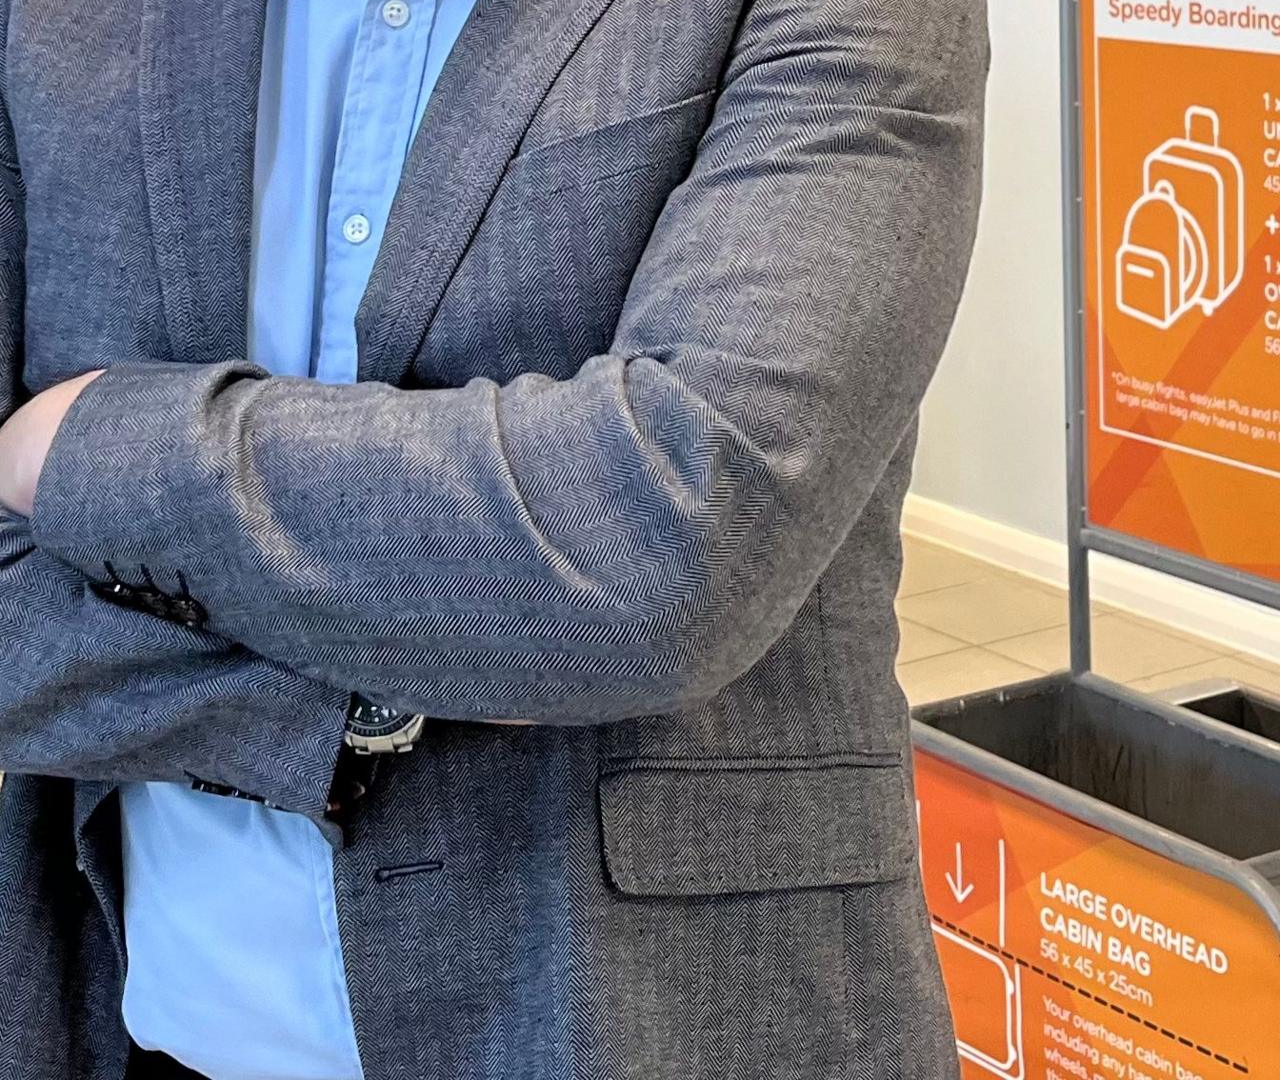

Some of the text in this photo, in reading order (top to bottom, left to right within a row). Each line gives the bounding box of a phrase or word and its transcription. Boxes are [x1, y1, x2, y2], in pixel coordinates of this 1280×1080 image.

[1263, 92, 1271, 111] 1
[1264, 255, 1272, 274] 1
[1115, 389, 1140, 407] large
[1141, 395, 1168, 413] cabin
[1168, 403, 1188, 421] bag
[1189, 410, 1212, 426] may
[1212, 413, 1237, 431] have
[1237, 420, 1250, 435] to
[1250, 426, 1265, 440] go
[1266, 428, 1277, 440] in
[1131, 375, 1154, 395] busy
[1228, 399, 1250, 417] Plus
[1251, 406, 1271, 422] and
[1040, 872, 1228, 974] LARGE OVERHEAD
[1040, 908, 1151, 977] CABIN BAG
[1040, 938, 1153, 1007] 56 x 45 x 25cm
[1042, 994, 1071, 1021] Your
[1073, 1014, 1134, 1054] overhead
[1135, 1046, 1173, 1074] cabin
[1043, 1023, 1099, 1065] including
[1101, 1053, 1126, 1078] any
